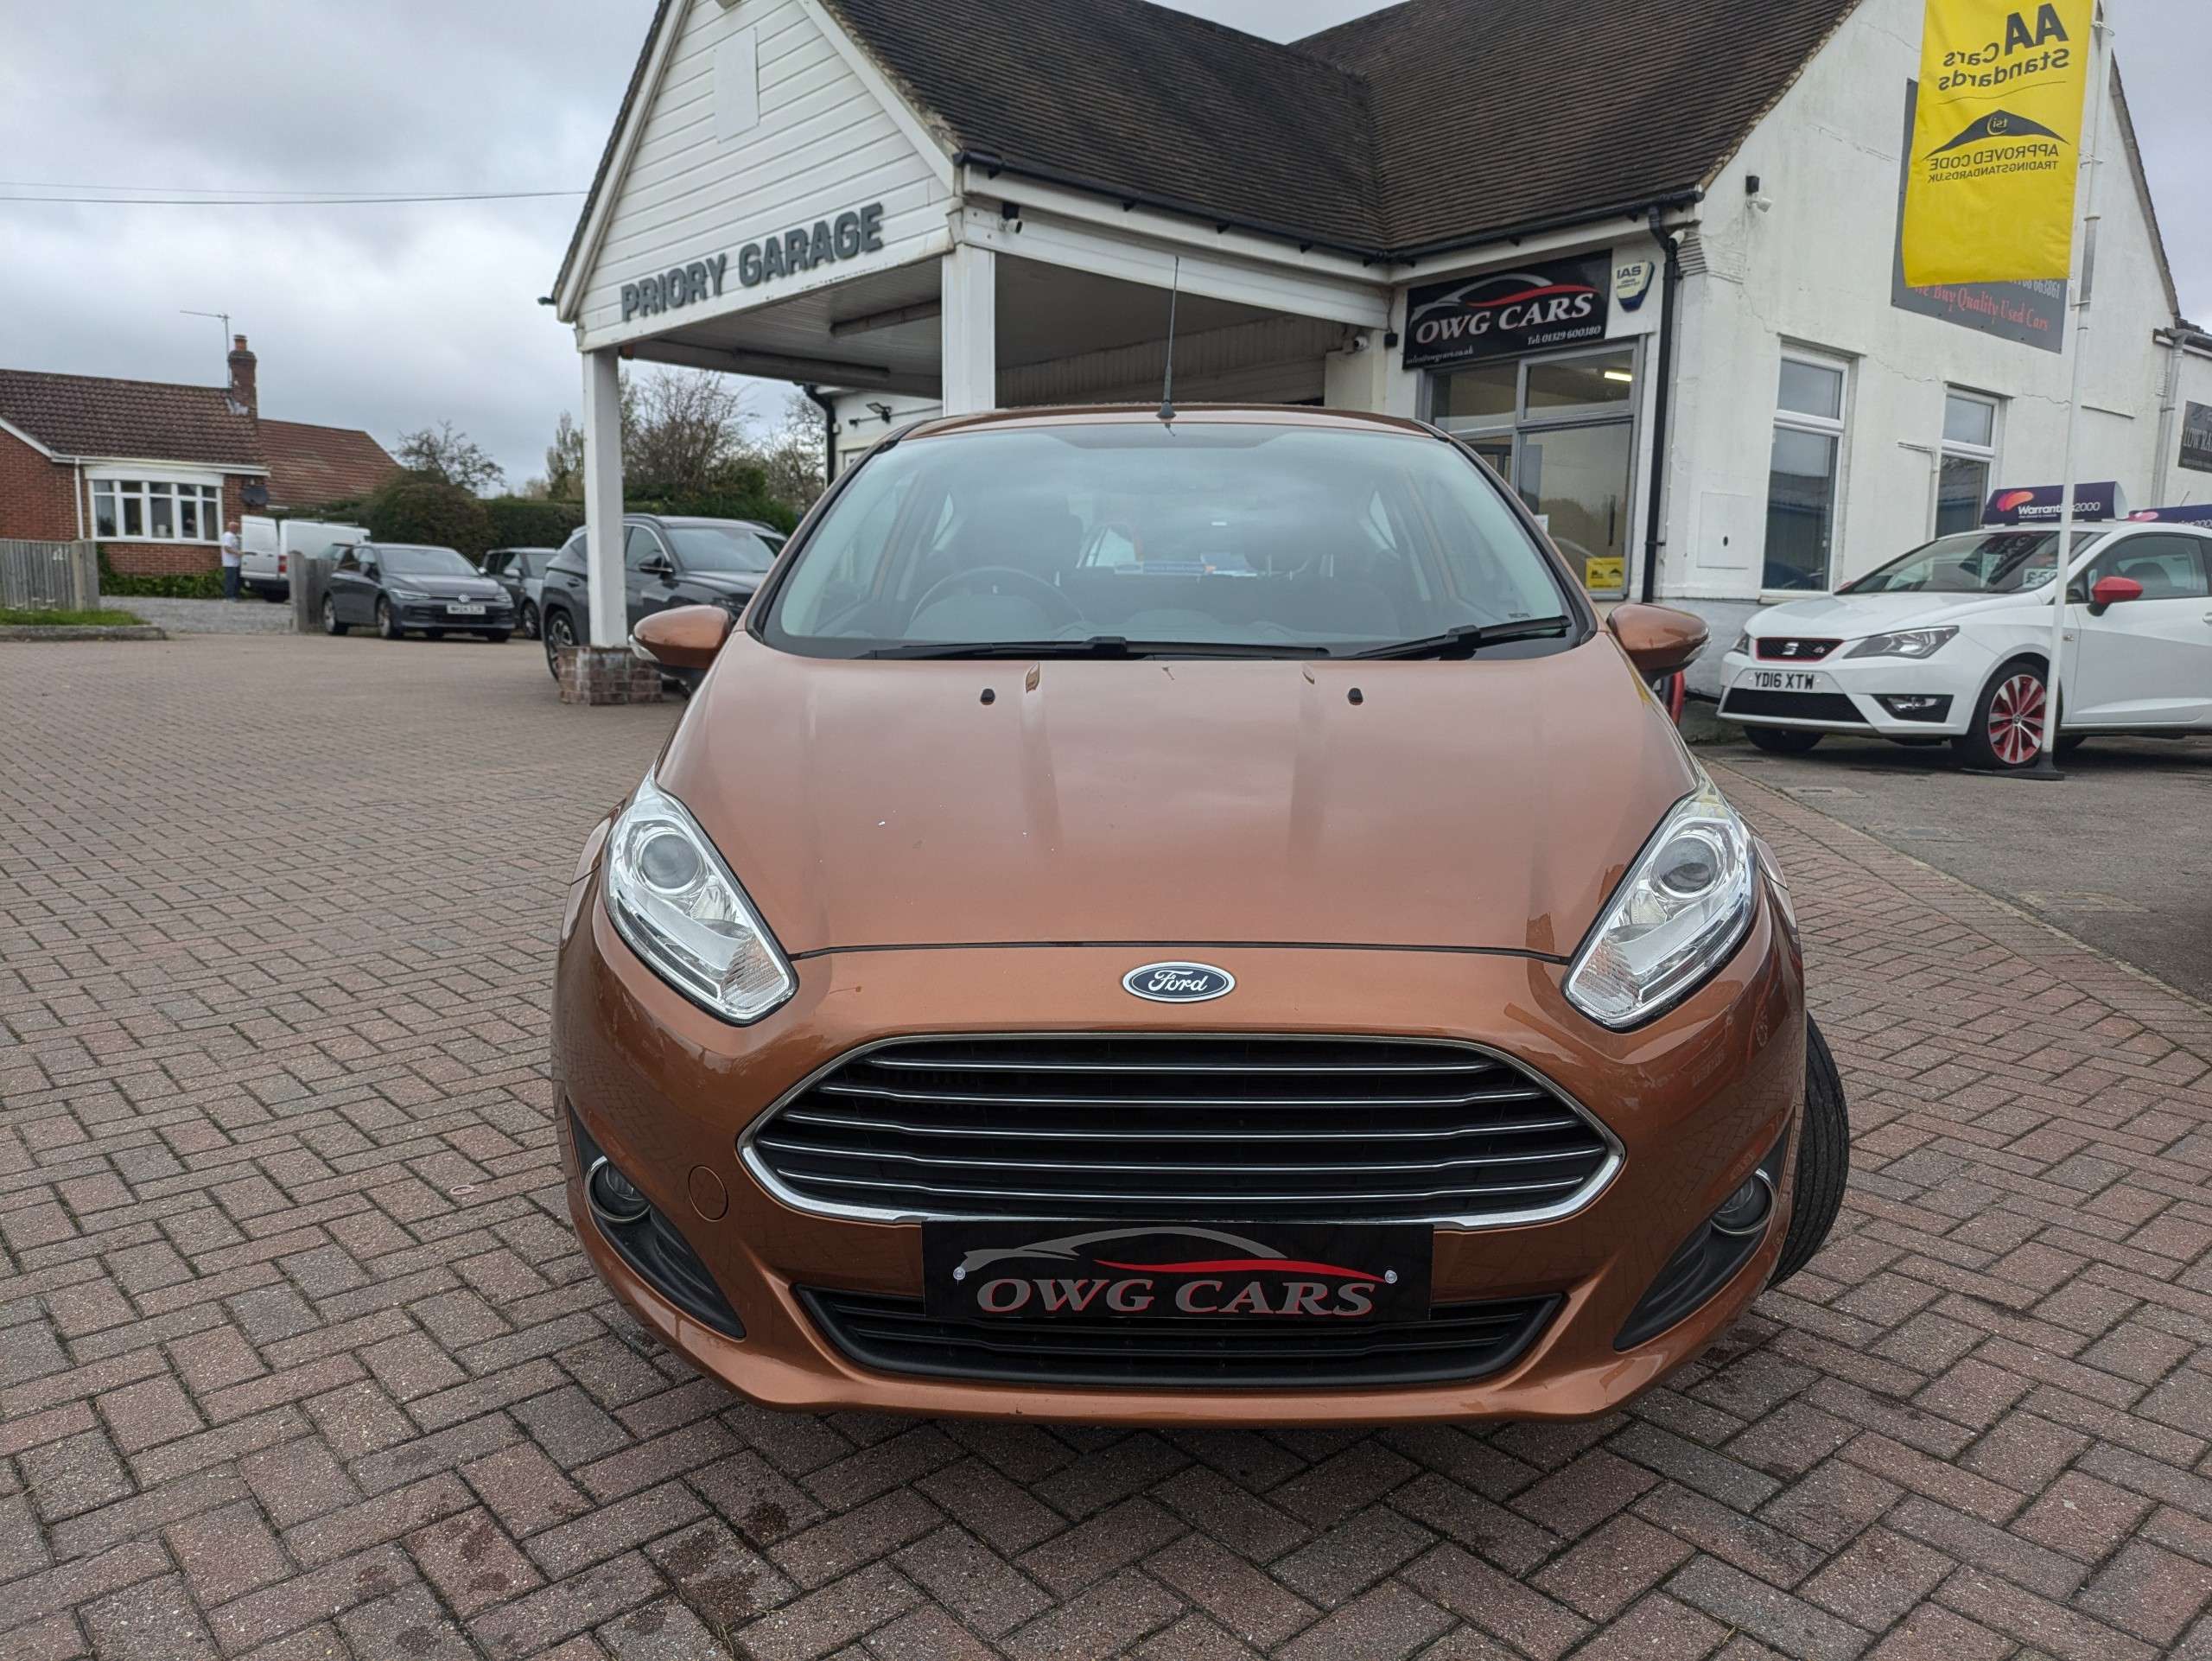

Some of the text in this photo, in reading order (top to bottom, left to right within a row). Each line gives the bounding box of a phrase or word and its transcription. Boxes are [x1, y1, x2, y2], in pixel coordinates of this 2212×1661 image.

[620, 202, 885, 322] PRIORY GARAGE
[1617, 265, 1641, 280] IAS
[1415, 293, 1593, 344] OWG CARS
[1934, 285, 1956, 311] Buy
[1957, 287, 1999, 324] Quality
[2000, 299, 2024, 324] Used
[2025, 308, 2049, 331] Cars
[1754, 672, 1815, 690] YD16 XTW
[1147, 970, 1209, 991] Ford
[976, 1278, 1376, 1316] OWG CARS
